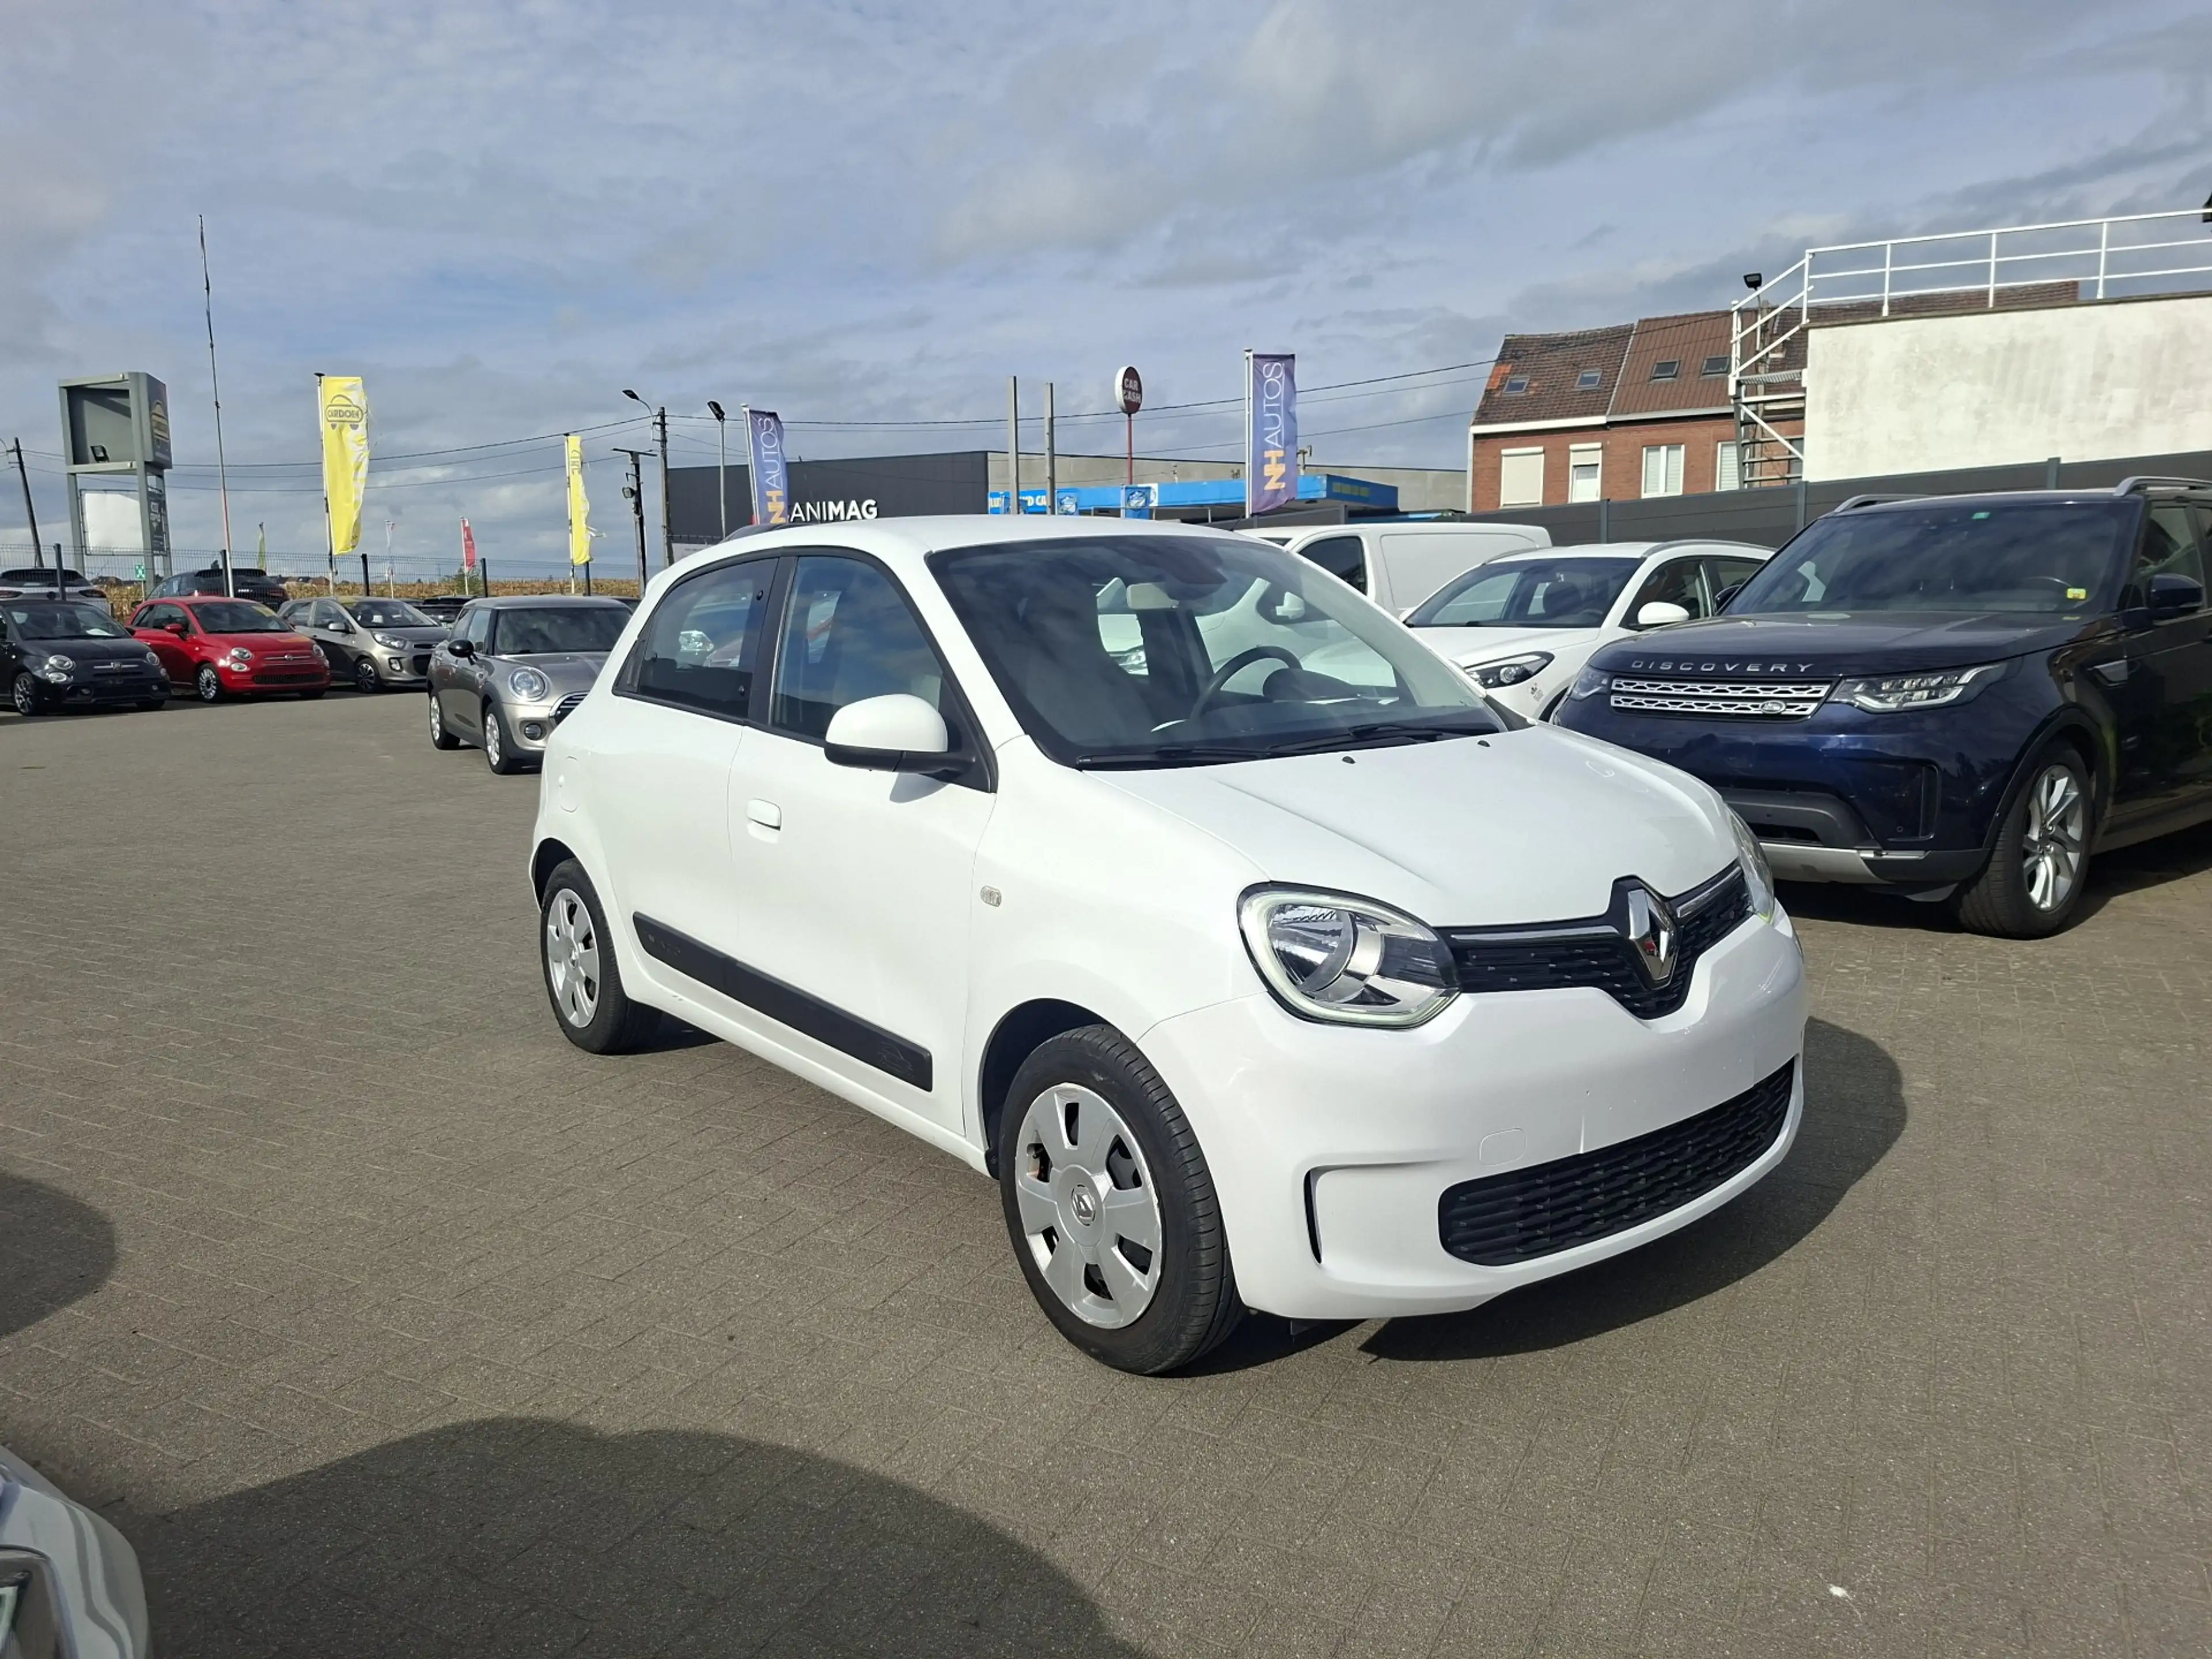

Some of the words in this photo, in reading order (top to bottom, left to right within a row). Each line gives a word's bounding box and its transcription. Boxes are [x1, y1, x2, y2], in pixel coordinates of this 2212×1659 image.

[1124, 377, 1138, 392] CAR
[790, 499, 878, 522] ANIMAG
[1631, 661, 1813, 672] DISCOVERY
